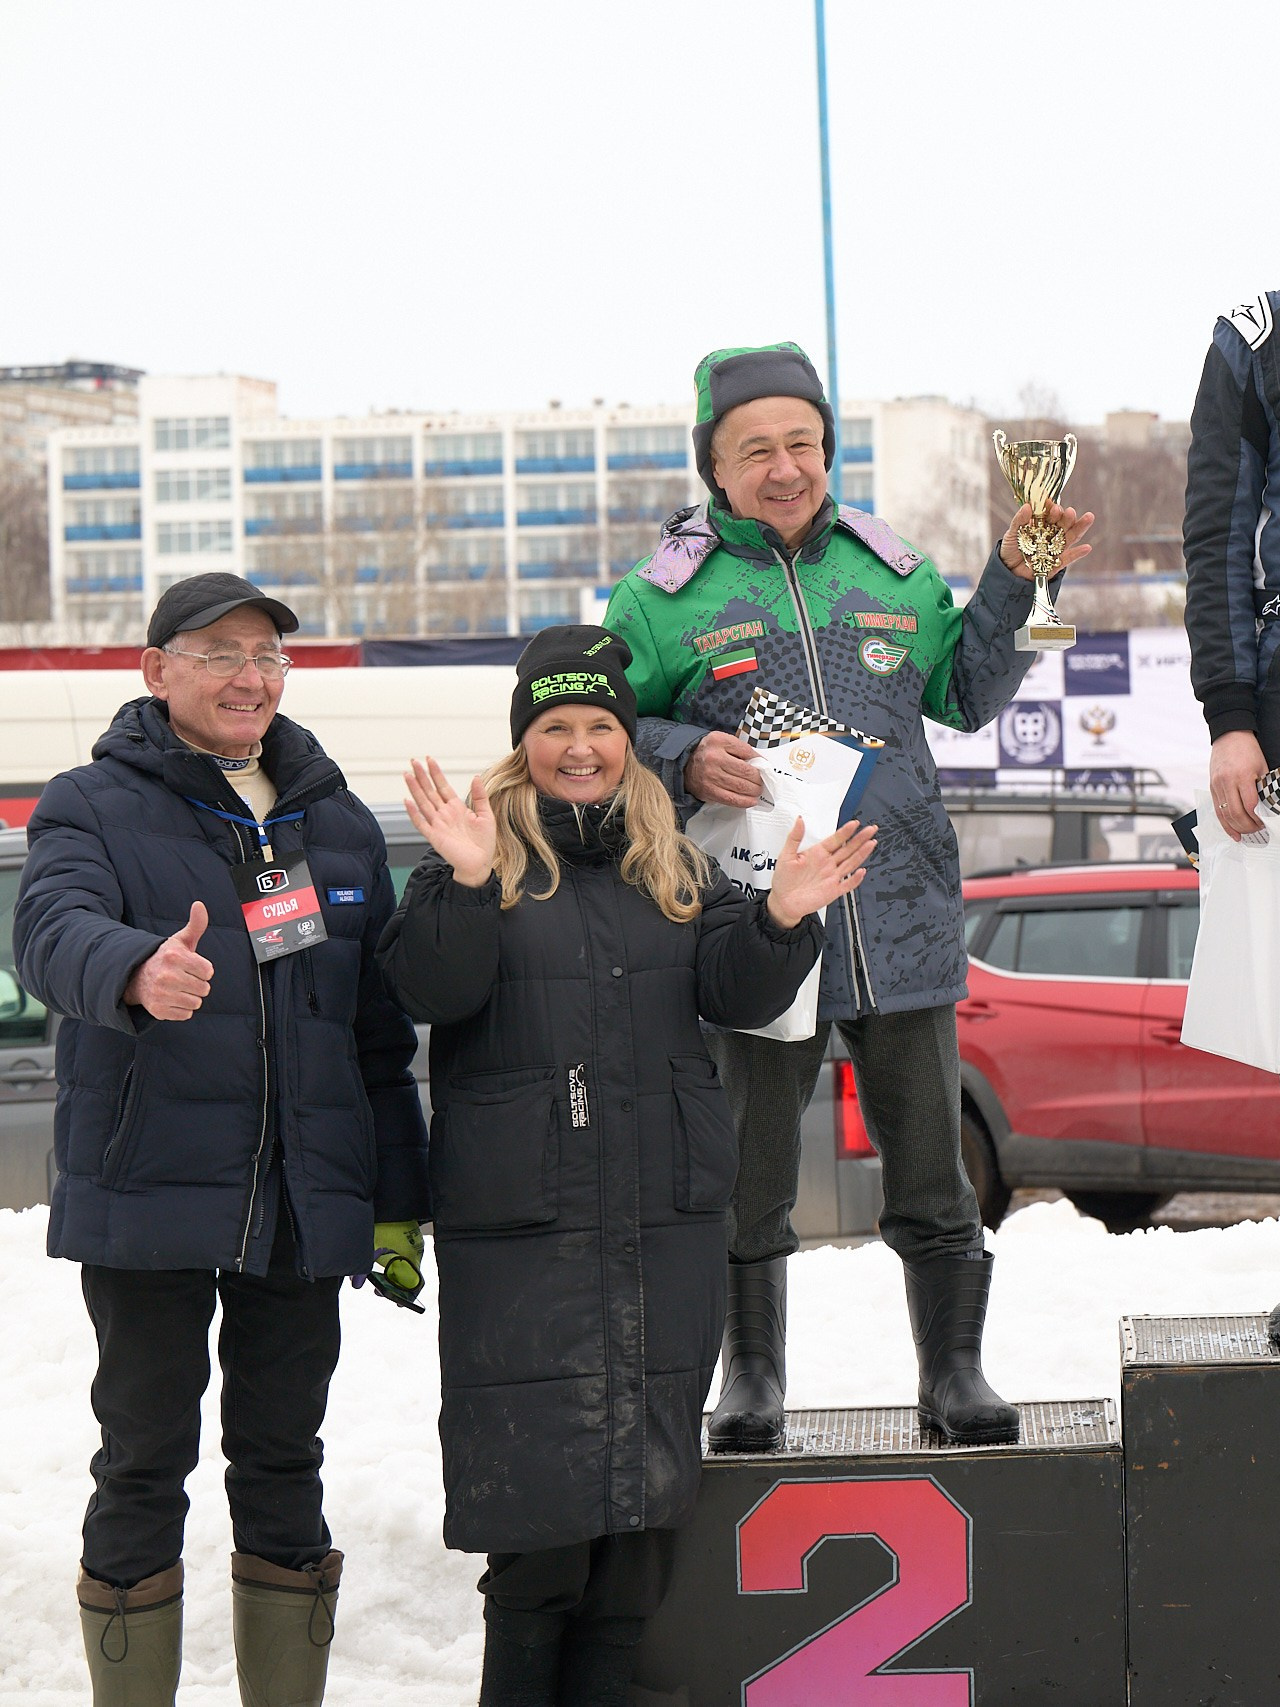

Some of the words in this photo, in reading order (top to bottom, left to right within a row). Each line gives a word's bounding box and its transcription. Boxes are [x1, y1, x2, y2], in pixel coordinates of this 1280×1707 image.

[855, 613, 917, 632] ТИМЕРХАН
[695, 621, 763, 652] ТАТАРСТАН
[262, 898, 299, 919] СУДЬЯ
[735, 1474, 975, 1707] 2
